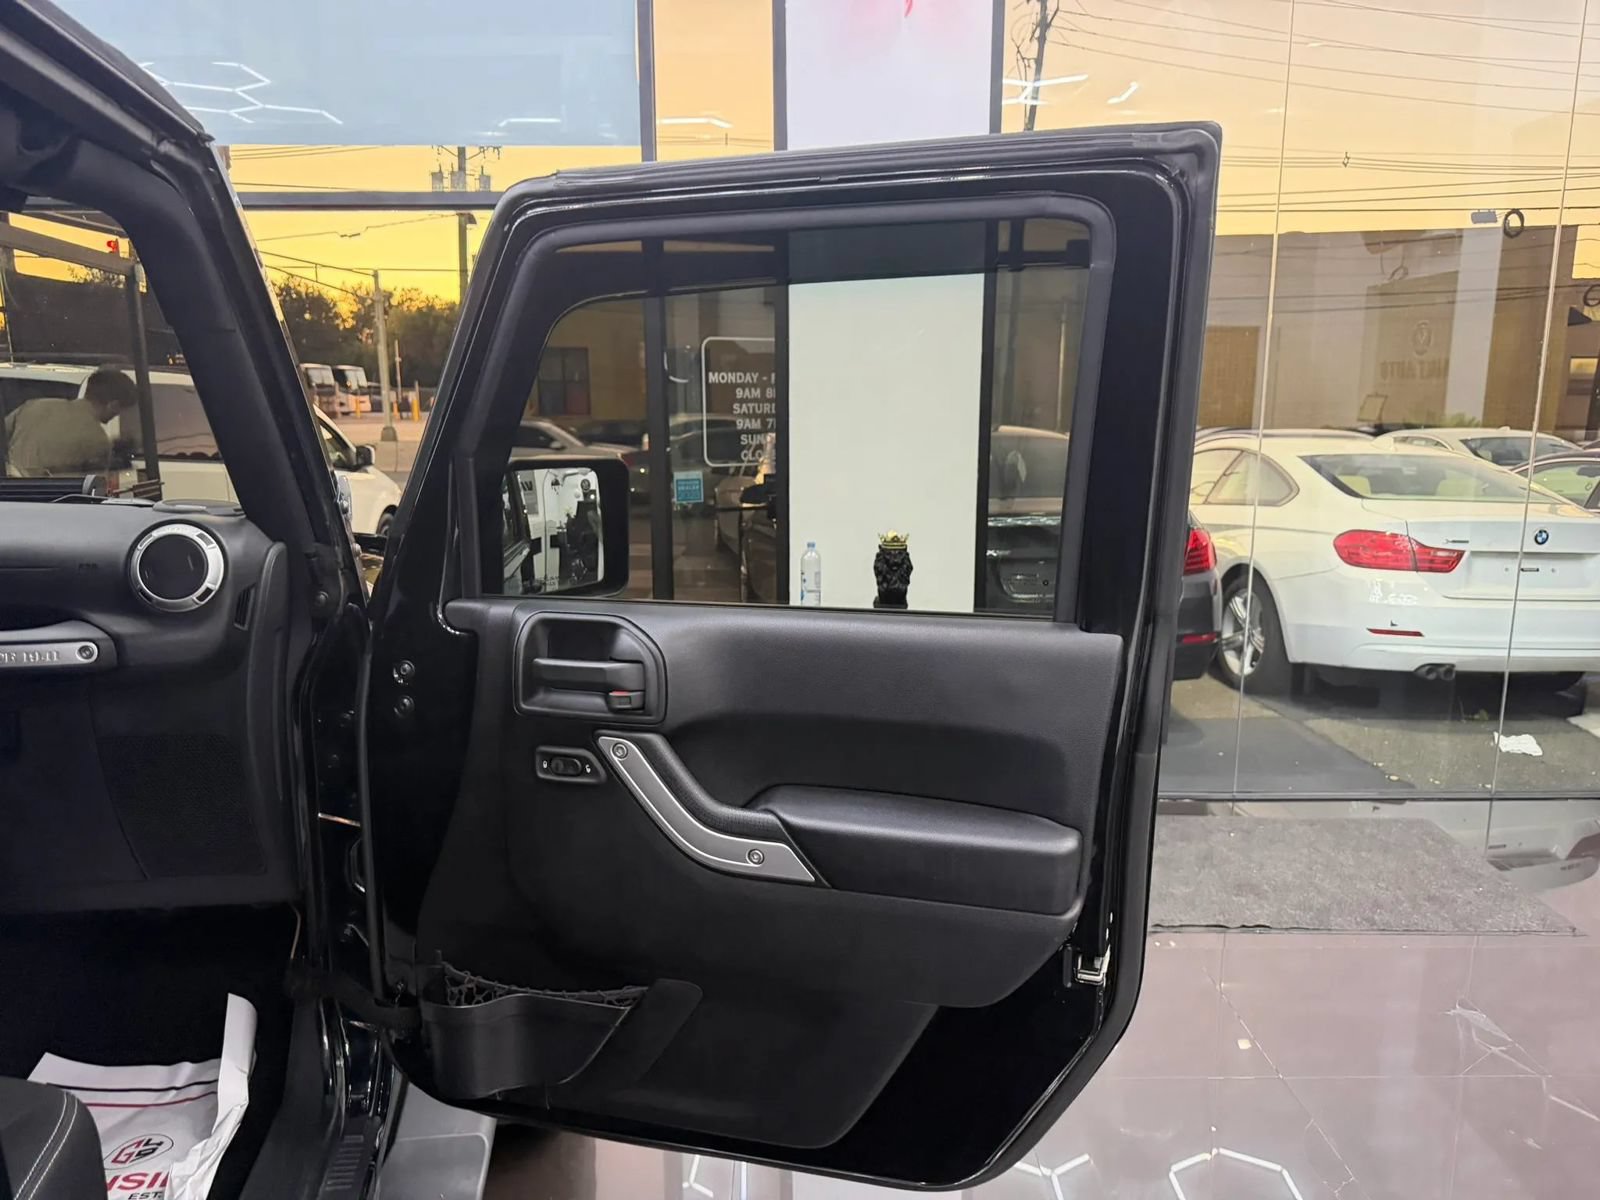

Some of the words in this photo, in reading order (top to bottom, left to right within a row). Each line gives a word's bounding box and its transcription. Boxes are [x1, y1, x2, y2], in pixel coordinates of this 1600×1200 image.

[708, 372, 759, 384] MONDAY
[735, 387, 761, 399] 9AM
[766, 387, 776, 399] 8
[736, 418, 761, 430] 9AM
[766, 418, 776, 430] 7
